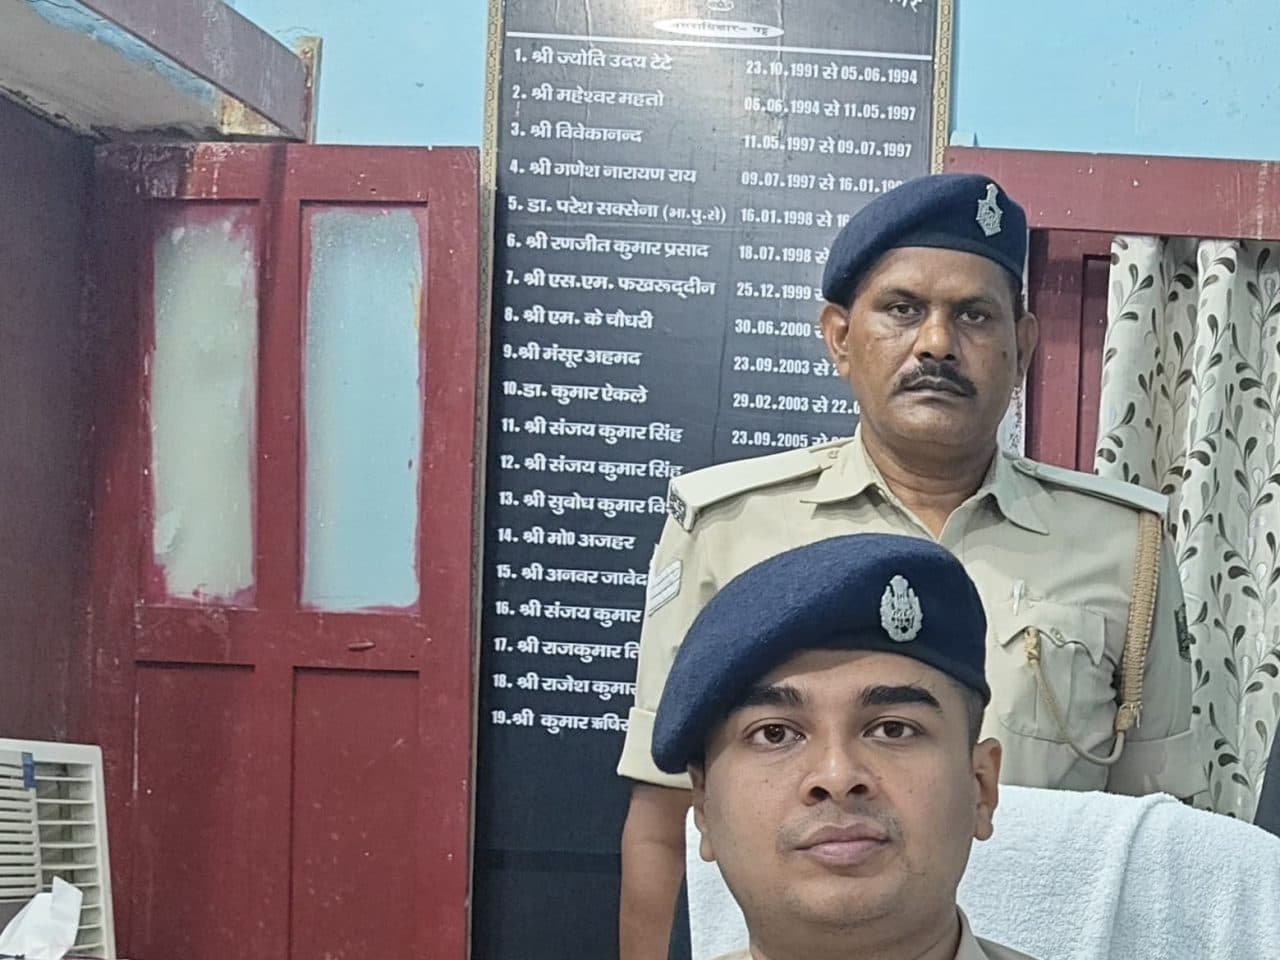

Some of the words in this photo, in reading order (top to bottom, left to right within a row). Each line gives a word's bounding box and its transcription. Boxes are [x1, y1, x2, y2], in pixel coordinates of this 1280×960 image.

[515, 48, 527, 62] 1.
[532, 46, 553, 64] श्री
[557, 48, 605, 67] ज्योति
[610, 54, 646, 68] उदय
[650, 54, 673, 70] टेटे
[746, 60, 819, 78] 23.10.1991
[822, 62, 839, 80] से
[840, 65, 918, 85] 05.06.1994
[512, 84, 527, 99] 2.
[531, 83, 553, 101] श्री
[556, 85, 617, 104] महेश्वर
[619, 90, 664, 107] महतो
[823, 99, 840, 117] से
[844, 103, 916, 121] 11.05.1997
[510, 122, 526, 136] 3.
[530, 120, 552, 138] श्री
[556, 121, 643, 143] विवेकानन्द
[743, 135, 816, 151] 11.05.1997
[818, 136, 835, 154] से
[837, 141, 912, 158] 09.07.1997
[509, 159, 525, 174] 4.
[529, 157, 551, 175] श्री
[554, 160, 601, 178] गणेश
[603, 165, 665, 181] नारायण
[668, 169, 697, 183] राय
[741, 171, 816, 189] 09.07.1997
[818, 173, 835, 191] से
[839, 176, 903, 193] 16.01.19
[508, 196, 523, 210] 5.
[527, 198, 552, 212] डा.
[556, 196, 594, 215] परेश
[597, 199, 658, 218] सक्सेना
[740, 208, 813, 226] 16.01.1998
[815, 210, 833, 228] से
[506, 233, 521, 247] 6.
[526, 231, 548, 249] श्री
[551, 232, 611, 252] रणजीत
[613, 240, 662, 259] कुमार
[665, 243, 710, 258] प्रसाद
[738, 245, 811, 263] 18.07.1998
[505, 270, 520, 284] 7.
[523, 268, 545, 286] श्री
[736, 281, 812, 300] 25.12.1999
[504, 307, 519, 321] 8.
[523, 305, 545, 323] श्री
[548, 310, 581, 325] एम.
[584, 308, 604, 325] के
[735, 319, 811, 337] 30.06.2000
[733, 356, 810, 375] 23.09.2003
[813, 358, 830, 377] से
[551, 384, 600, 405] कुमार
[732, 393, 809, 411] 29.02.2003
[812, 395, 829, 413] से
[501, 418, 521, 432] 11.
[524, 416, 547, 434] श्री
[549, 418, 598, 437] संजय
[598, 425, 649, 445] कुमार
[649, 422, 684, 443] सिंह
[732, 430, 809, 448] 23.09.2005
[500, 455, 521, 470] 12.
[524, 453, 547, 471] श्री
[549, 455, 598, 474] संजय
[598, 462, 649, 482] कुमार
[649, 459, 684, 478] सिंह
[499, 491, 519, 506] 13.
[523, 489, 546, 508] श्री
[597, 498, 646, 518] कुमार
[498, 528, 518, 542] 14.
[522, 526, 545, 544] श्री
[577, 534, 636, 550] अजहर
[496, 564, 517, 579] 15.
[521, 562, 544, 581] श्री
[545, 567, 600, 584] अनवर
[495, 601, 515, 615] 16.
[518, 599, 542, 617] श्री
[544, 602, 592, 620] संजय
[593, 609, 643, 628] कुमार
[493, 637, 513, 652] 17.
[517, 636, 540, 654] श्री
[541, 641, 622, 663] राजकुमार
[492, 674, 513, 688] 18.
[516, 672, 539, 690] श्री
[541, 675, 590, 693] राजेश
[540, 714, 590, 734] कुमार
[590, 713, 630, 732] ऋषिर
